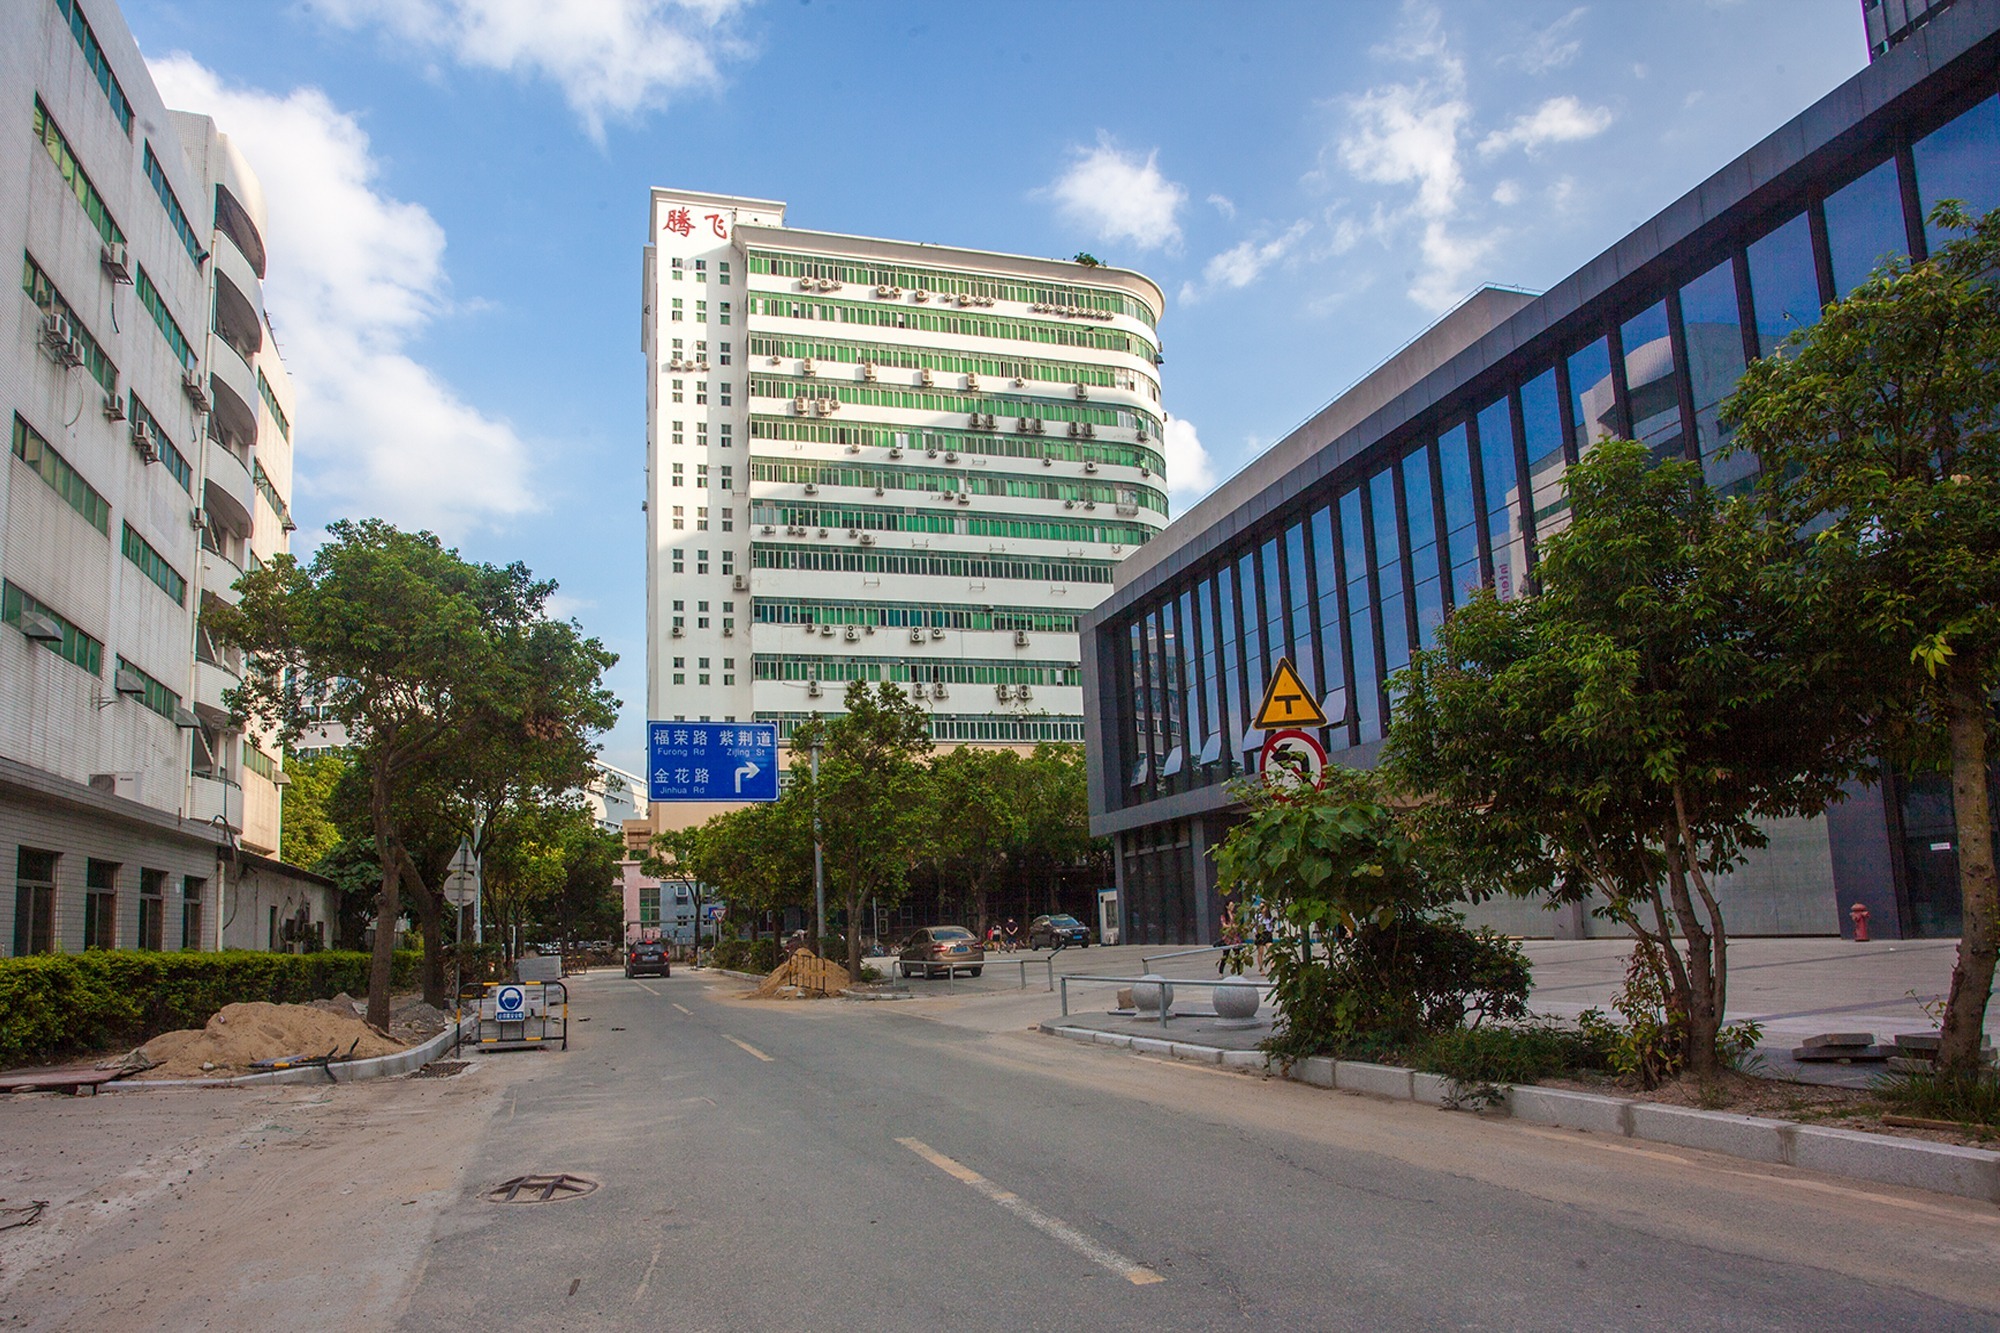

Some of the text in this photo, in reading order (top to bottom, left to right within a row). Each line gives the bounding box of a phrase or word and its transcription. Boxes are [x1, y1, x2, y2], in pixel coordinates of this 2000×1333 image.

[663, 206, 727, 239] 腾飞
[654, 729, 708, 746] 福荣路
[719, 730, 771, 746] 紫荆道
[657, 748, 705, 757] Furong Rd
[726, 748, 765, 757] Zijing St
[654, 768, 710, 784] 金花路
[660, 786, 705, 794] Jinhua Rd
